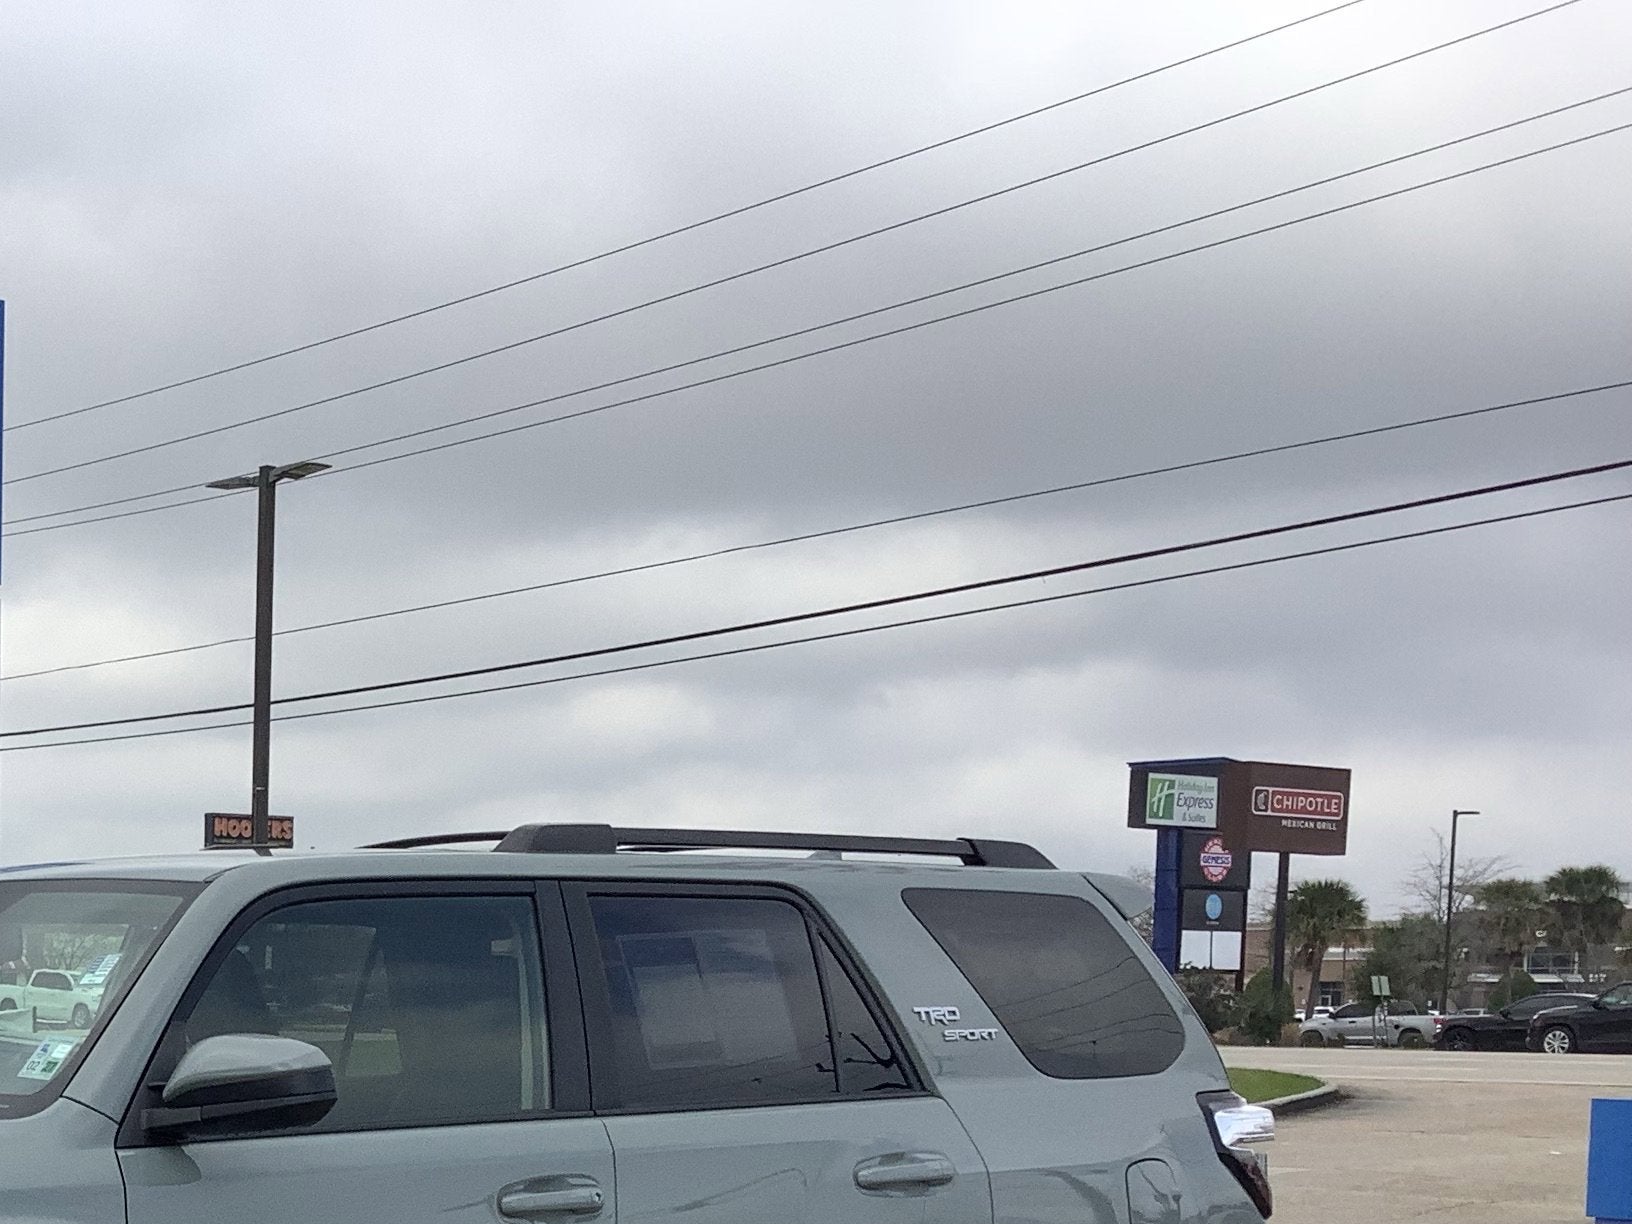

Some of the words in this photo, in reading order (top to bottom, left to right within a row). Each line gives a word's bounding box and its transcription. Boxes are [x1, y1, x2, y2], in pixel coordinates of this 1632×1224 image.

[1176, 792, 1214, 811] Express
[1273, 795, 1339, 813] CHIPOTLE
[214, 817, 292, 839] HOORS
[1281, 819, 1315, 829] MEXICAN
[1316, 821, 1337, 831] GRILL
[943, 1028, 999, 1041] SPORT
